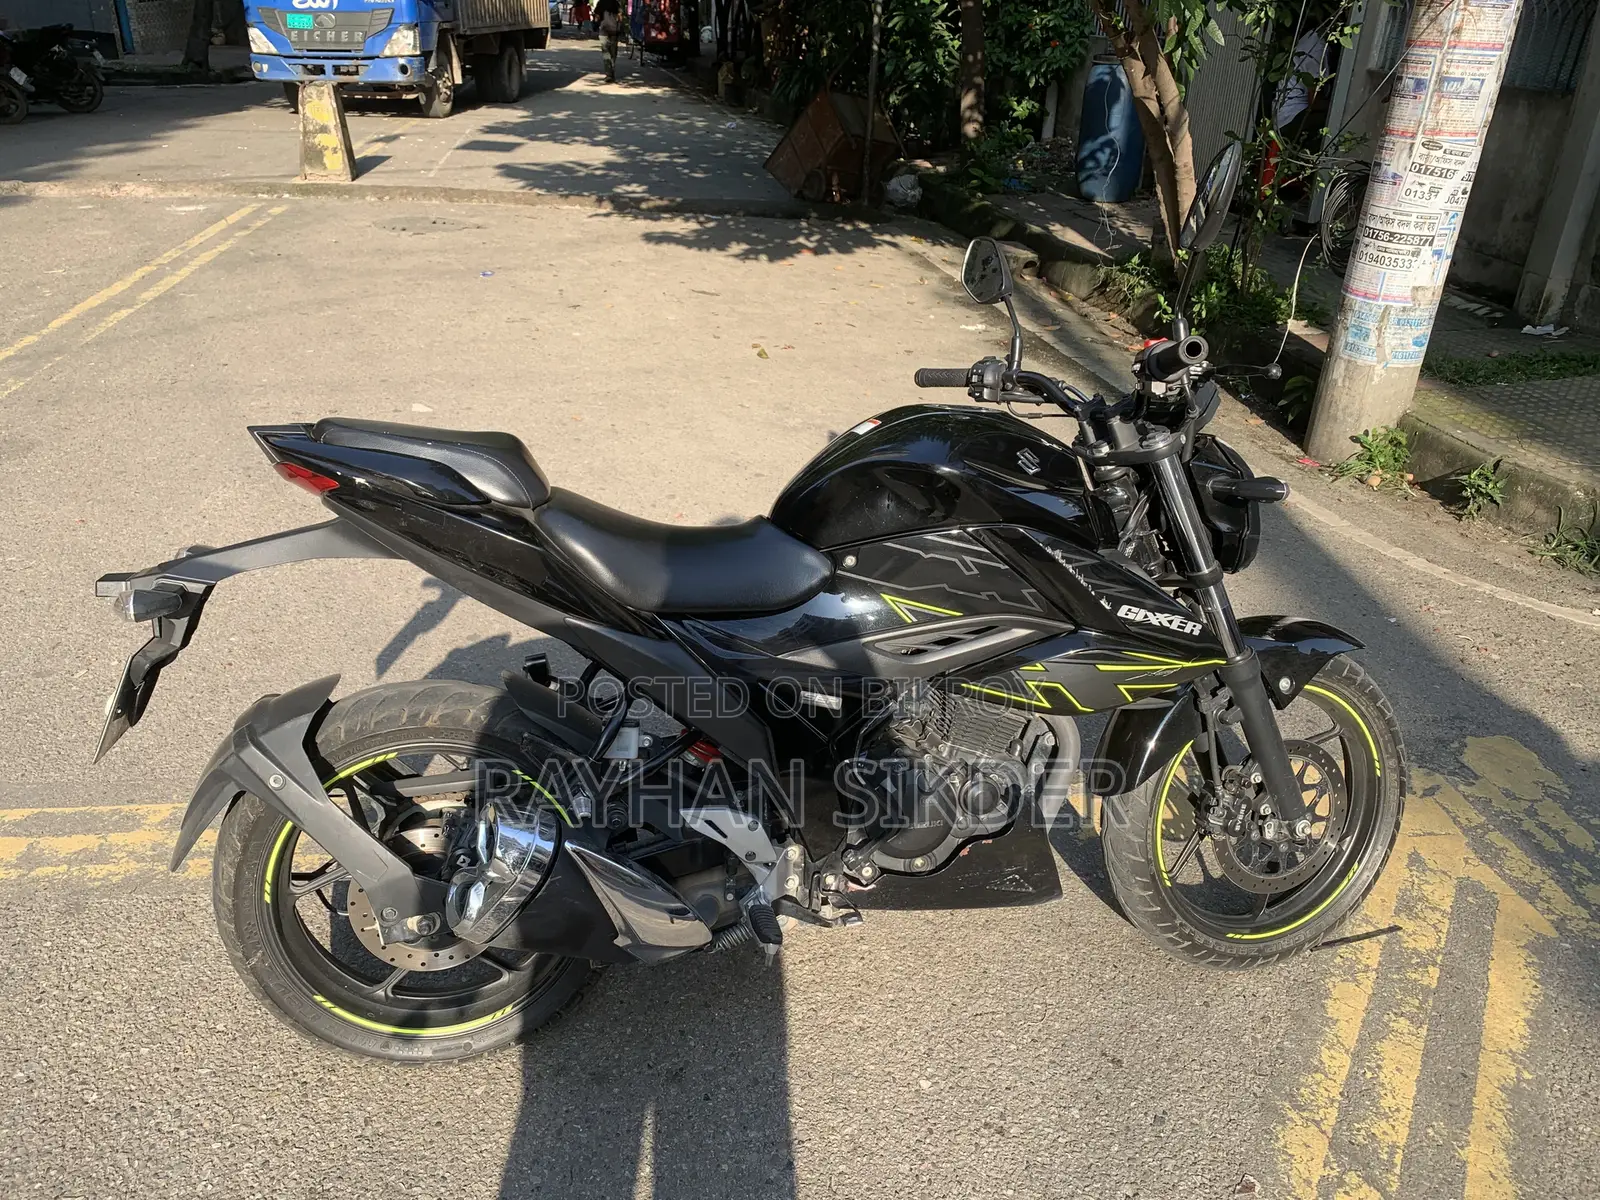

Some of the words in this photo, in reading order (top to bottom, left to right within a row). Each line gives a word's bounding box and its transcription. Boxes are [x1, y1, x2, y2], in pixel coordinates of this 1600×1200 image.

[290, 31, 364, 42] EICHER
[1411, 163, 1458, 179] 017516
[1364, 227, 1434, 246] 01756-225877
[1359, 250, 1417, 269] 019403533
[1117, 605, 1203, 636] GIXXER
